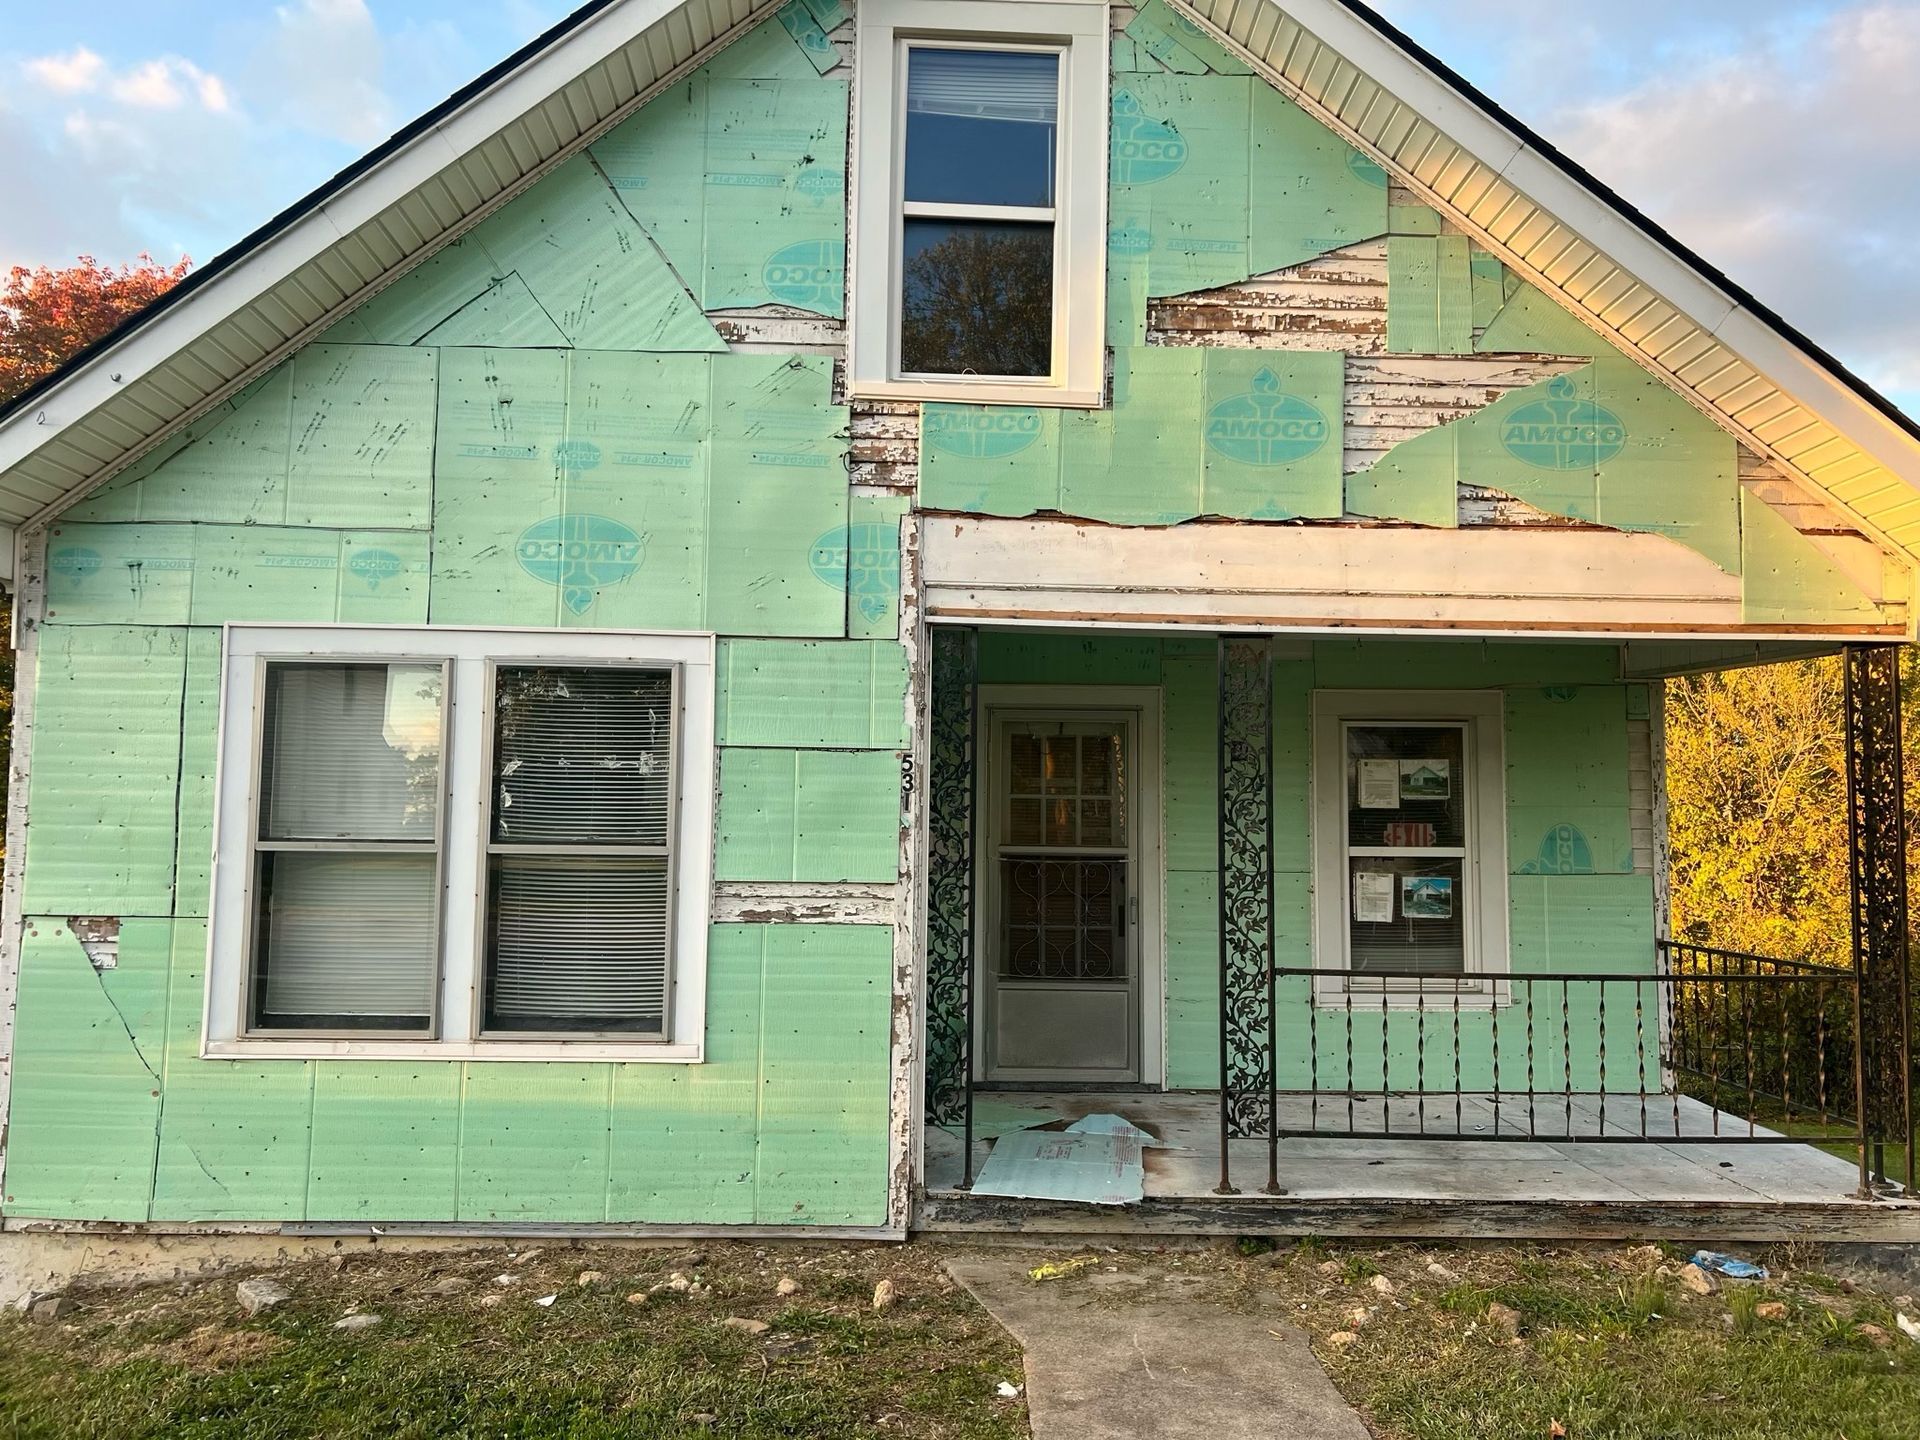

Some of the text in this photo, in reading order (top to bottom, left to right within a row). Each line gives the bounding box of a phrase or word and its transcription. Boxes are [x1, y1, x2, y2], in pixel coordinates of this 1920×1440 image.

[1112, 142, 1185, 160] OCO
[923, 411, 1040, 431] AMOCO
[1207, 419, 1326, 439] AMOCO
[1504, 425, 1623, 444] AMOCO
[520, 541, 642, 561] AMOCO
[350, 559, 401, 570] AMOCO
[902, 754, 914, 811] 531
